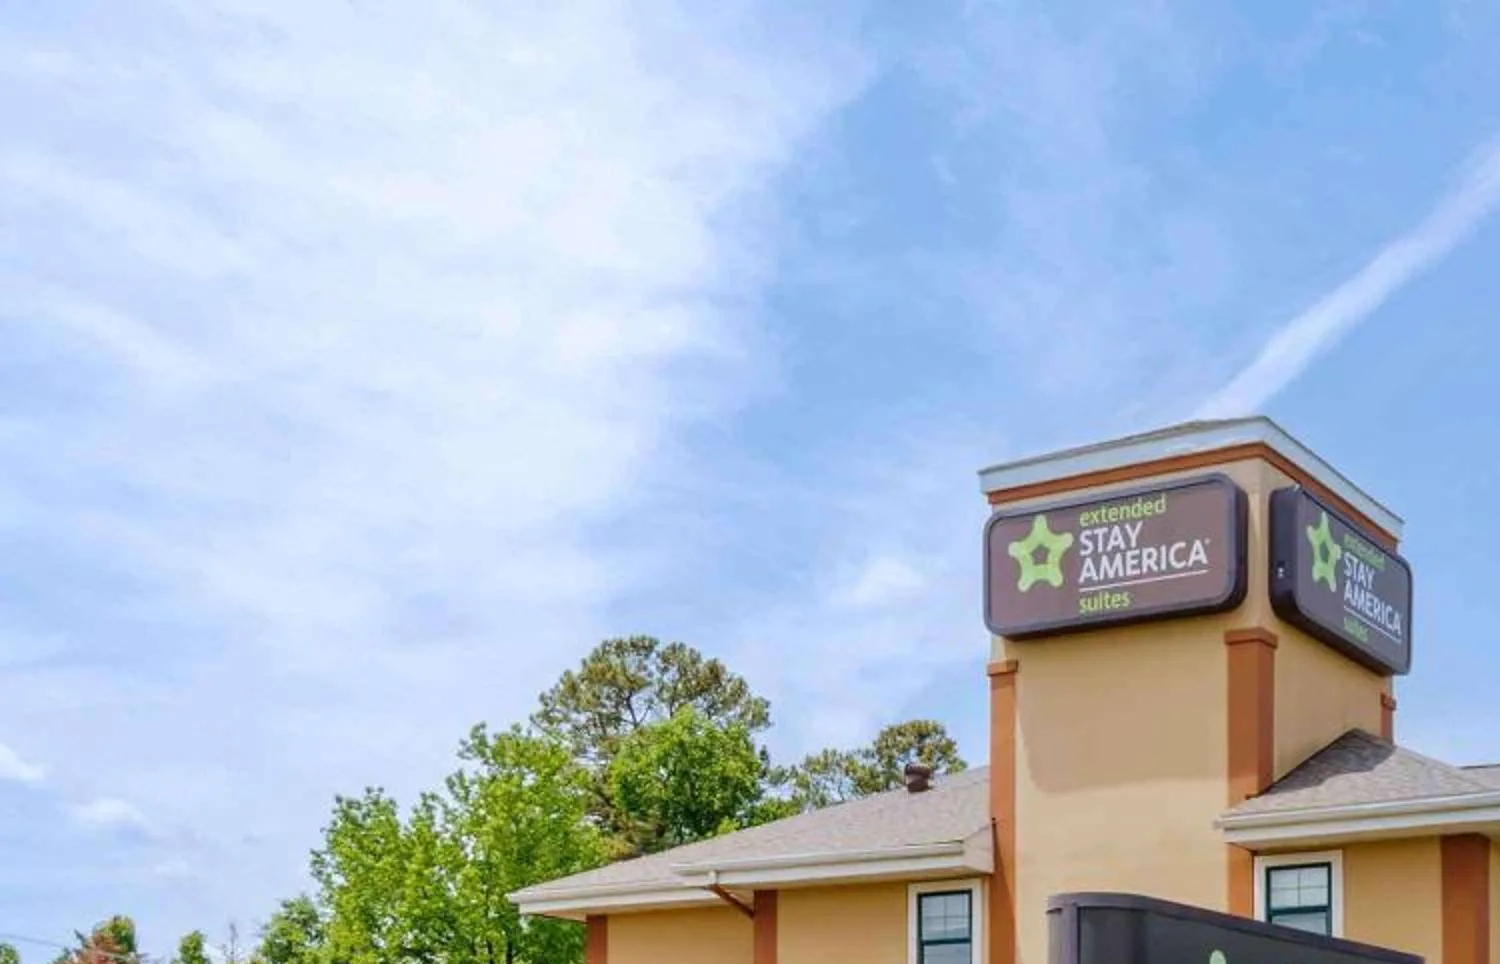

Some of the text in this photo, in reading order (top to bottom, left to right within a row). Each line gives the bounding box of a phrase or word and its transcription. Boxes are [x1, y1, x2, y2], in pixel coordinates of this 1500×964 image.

[1079, 493, 1167, 526] extended
[1079, 520, 1143, 556] STAY
[1078, 538, 1208, 584] AMERICA
[1343, 551, 1375, 589] STAY
[1079, 591, 1131, 614] suites
[1343, 579, 1401, 636] AMERICA
